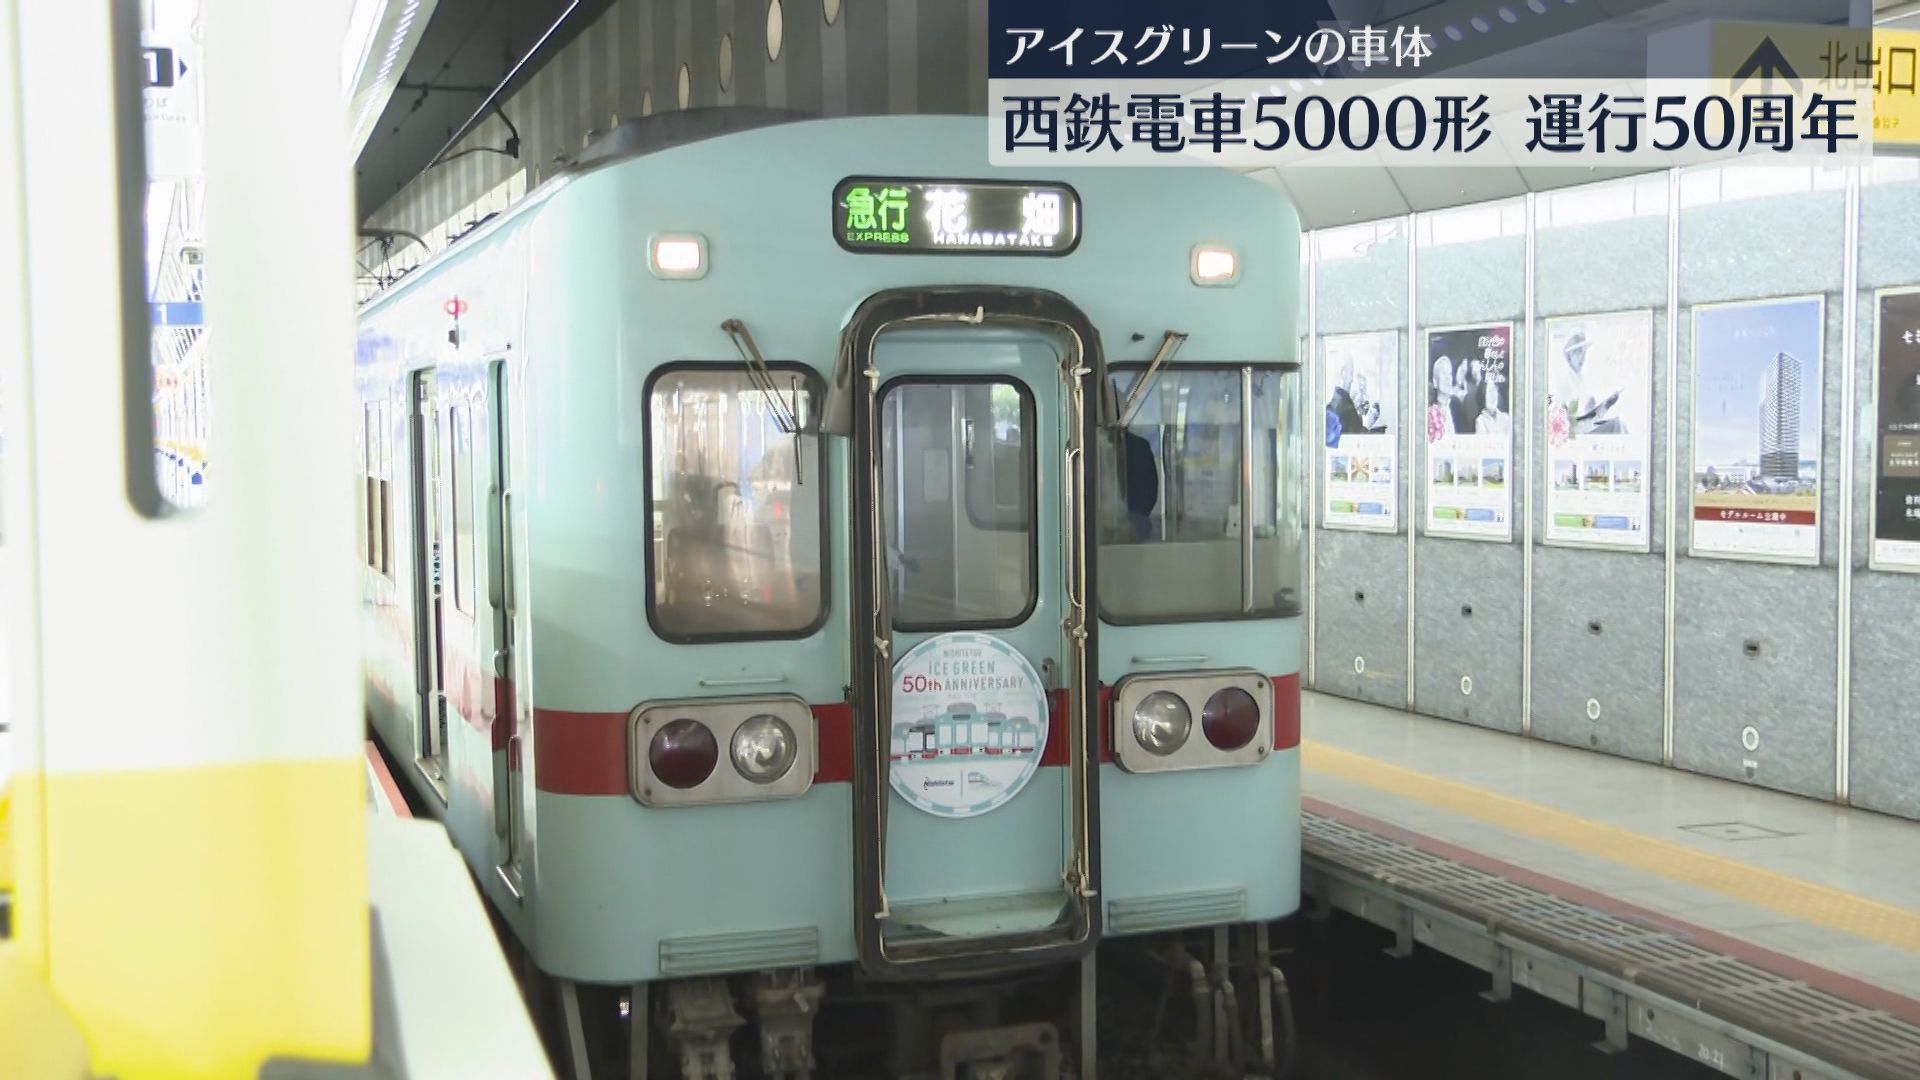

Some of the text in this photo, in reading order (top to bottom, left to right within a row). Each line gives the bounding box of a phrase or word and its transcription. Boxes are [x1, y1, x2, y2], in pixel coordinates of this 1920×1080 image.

[1819, 40, 1916, 94] 北出口
[846, 187, 909, 231] 急行
[847, 231, 909, 244] EXPRESS
[933, 231, 1054, 247] HANABATAKE
[928, 660, 996, 676] ICE GREEN
[902, 673, 1024, 693] 50th ANNIVERSARY
